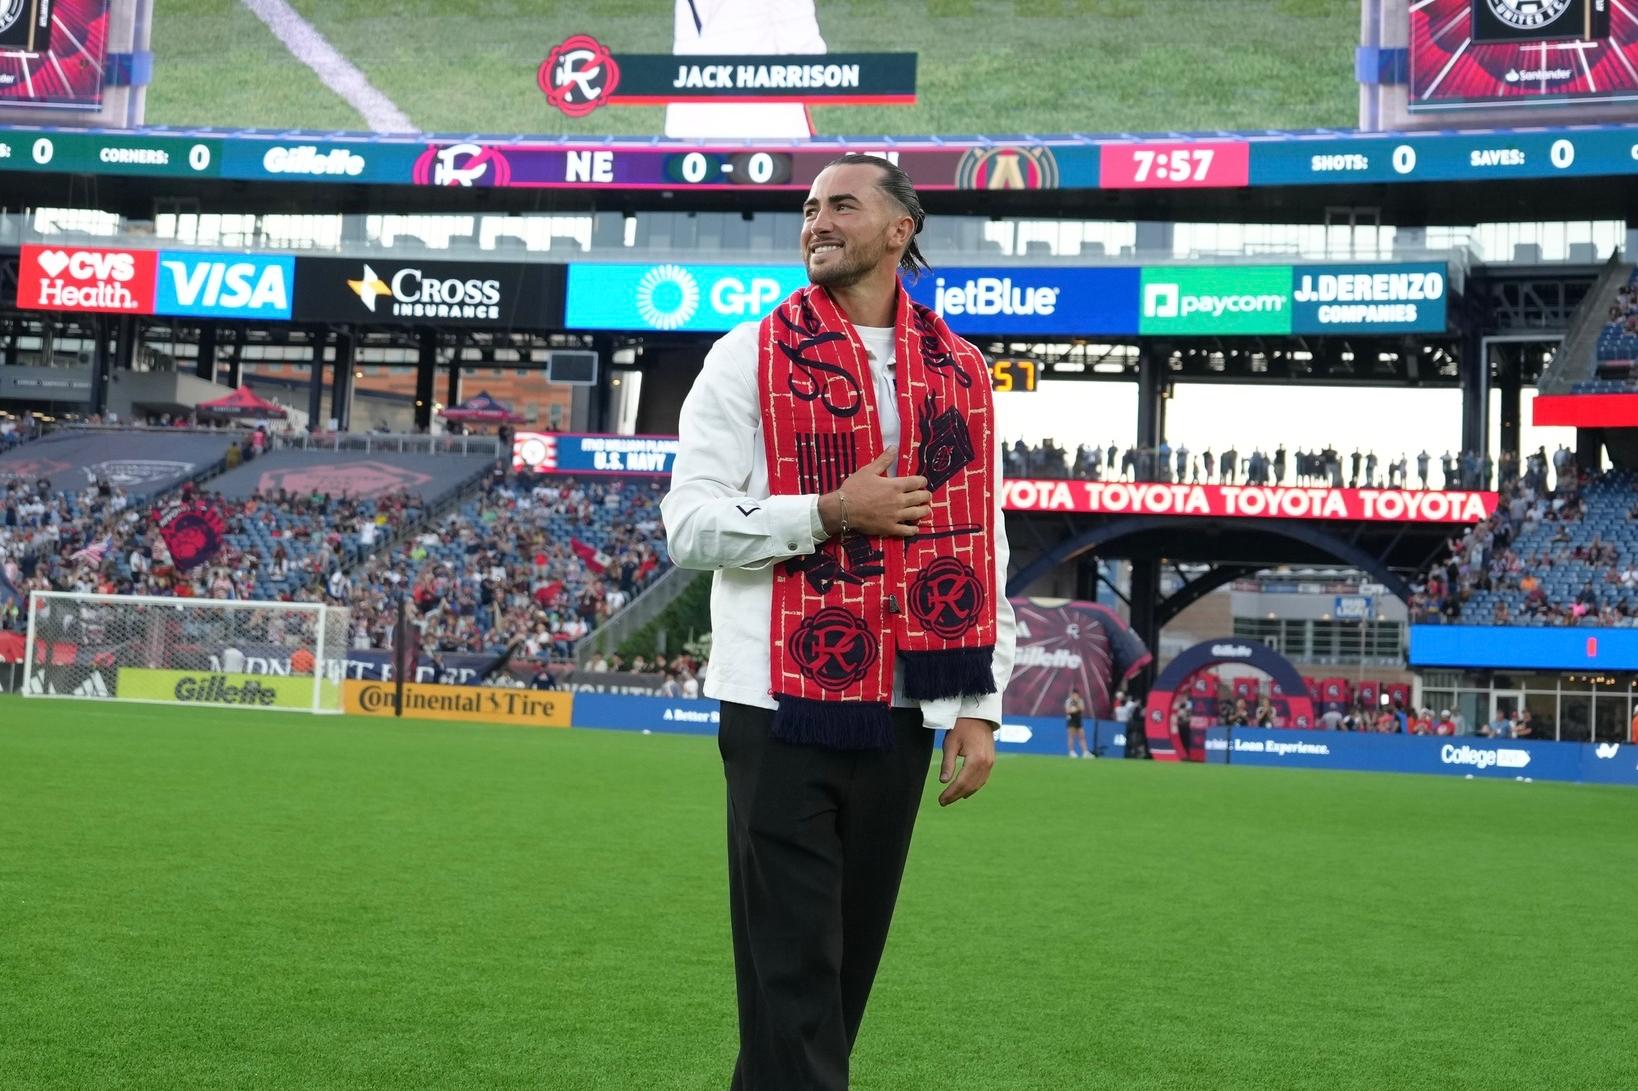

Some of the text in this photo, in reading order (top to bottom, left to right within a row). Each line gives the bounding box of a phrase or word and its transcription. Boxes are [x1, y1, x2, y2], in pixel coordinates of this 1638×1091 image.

[1496, 1, 1564, 25] UNITED FC
[673, 64, 860, 88] JACK HARRISON
[1519, 68, 1572, 81] Santander
[32, 138, 54, 164] 0
[100, 147, 169, 164] CORNERS:
[189, 144, 210, 171] 0
[263, 146, 365, 176] Gillette
[565, 150, 614, 183] NE
[682, 152, 707, 183] 0
[748, 152, 774, 184] 0
[1133, 150, 1214, 182] 7:57
[1311, 139, 1575, 174] SHOTS: 0 SAVES: 0
[69, 251, 135, 281] CVS
[39, 278, 131, 308] Health
[162, 261, 287, 309] VISA
[391, 268, 500, 304] CROSS
[711, 278, 780, 315] GP
[935, 278, 1056, 316] jetBlue
[393, 303, 499, 319] INSURANCE
[1181, 295, 1282, 316] paycom
[1318, 304, 1417, 323] COMPANIES
[990, 361, 1034, 391] 57
[594, 452, 667, 471] U.S. NAVY
[1002, 480, 1487, 521] YOTA TOYOTA TOYOTA TOYOTA
[1015, 645, 1082, 669] illette
[1211, 643, 1252, 657] Gillette
[175, 677, 276, 705] Gillette
[359, 685, 482, 713] Coninental
[504, 692, 555, 717] Tire
[663, 709, 673, 720] A
[674, 709, 711, 722] Better
[1234, 738, 1264, 752] Loan
[1265, 740, 1330, 756] Experience.
[1441, 744, 1497, 769] College
